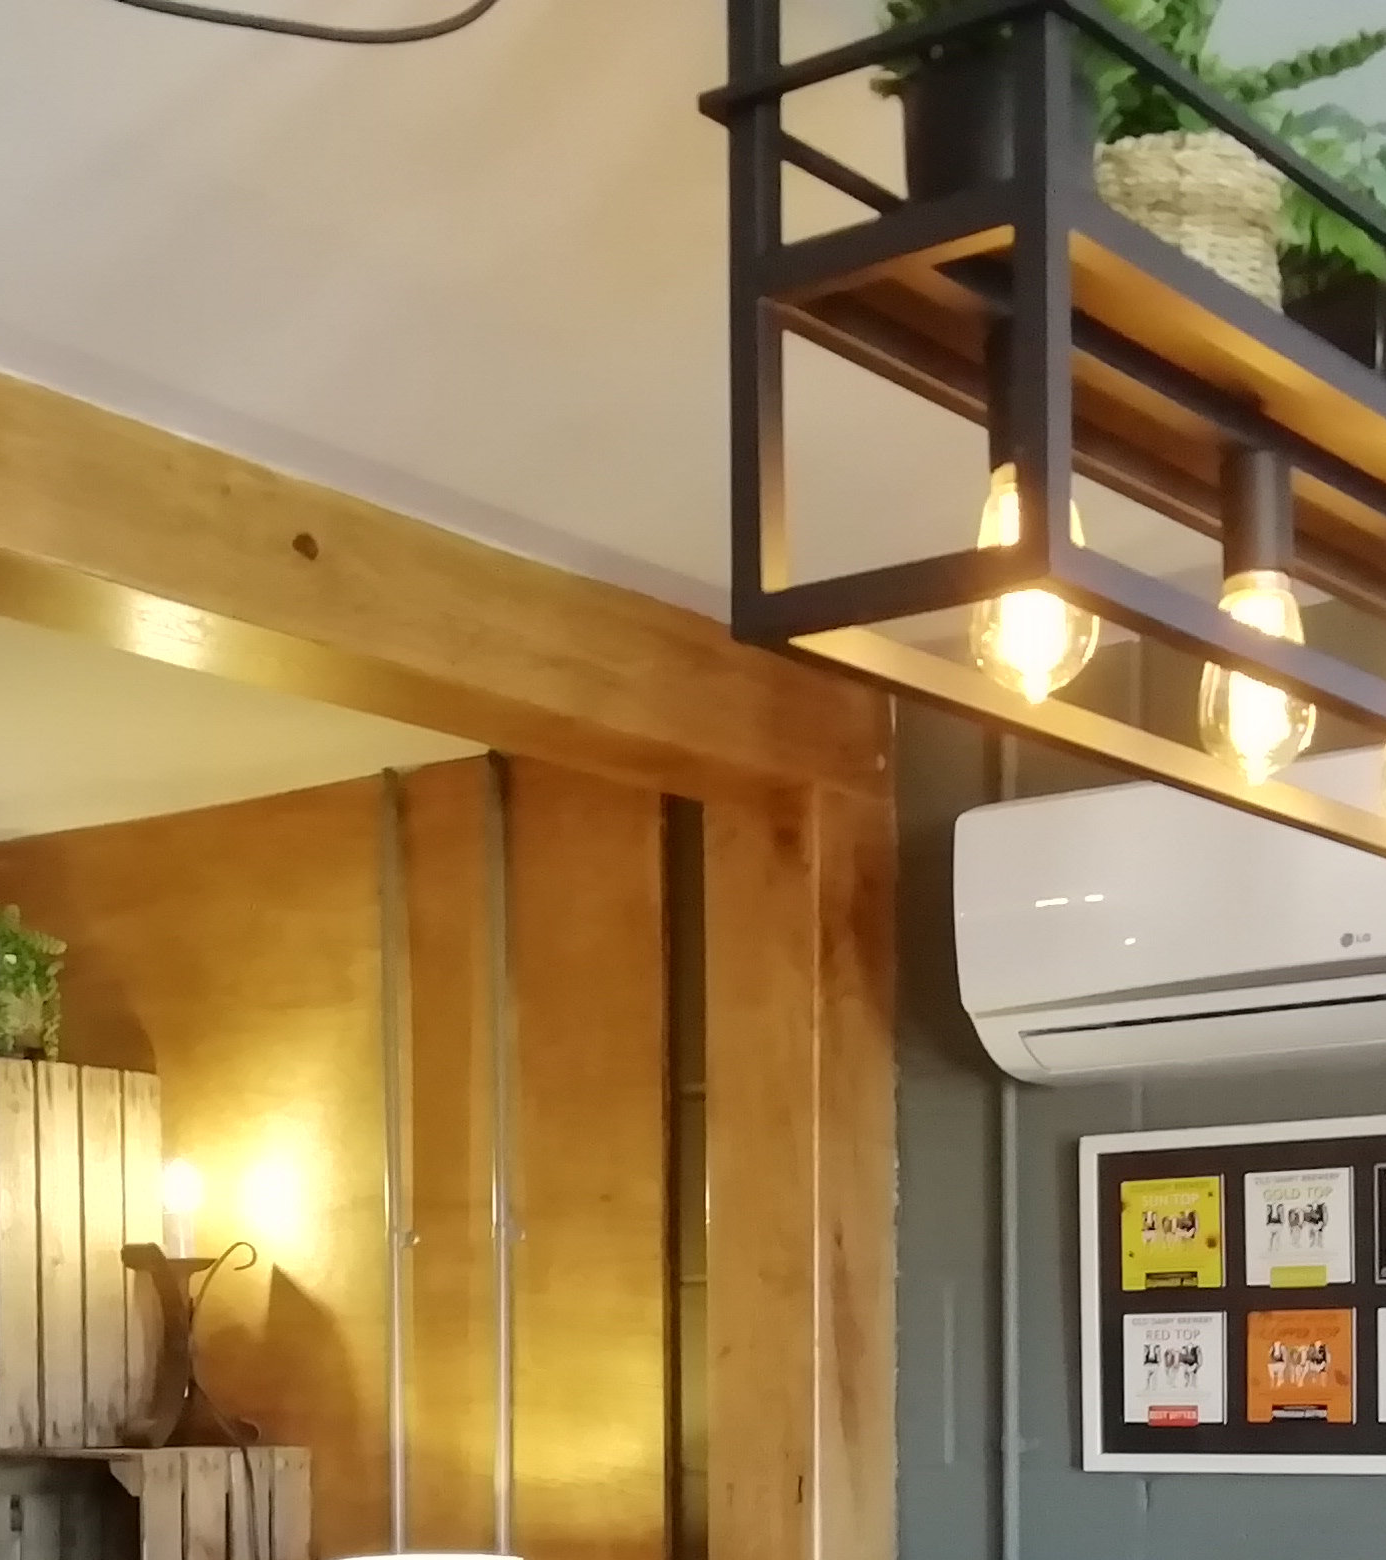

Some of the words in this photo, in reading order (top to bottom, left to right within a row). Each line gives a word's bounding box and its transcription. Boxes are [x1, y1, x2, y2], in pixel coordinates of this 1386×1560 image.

[1142, 1194, 1169, 1208] SUN
[1173, 1193, 1201, 1206] TOP
[1262, 1187, 1301, 1202] GOLD
[1306, 1185, 1334, 1199] TOP
[1146, 1329, 1171, 1341] RED
[1174, 1329, 1201, 1341] TOP
